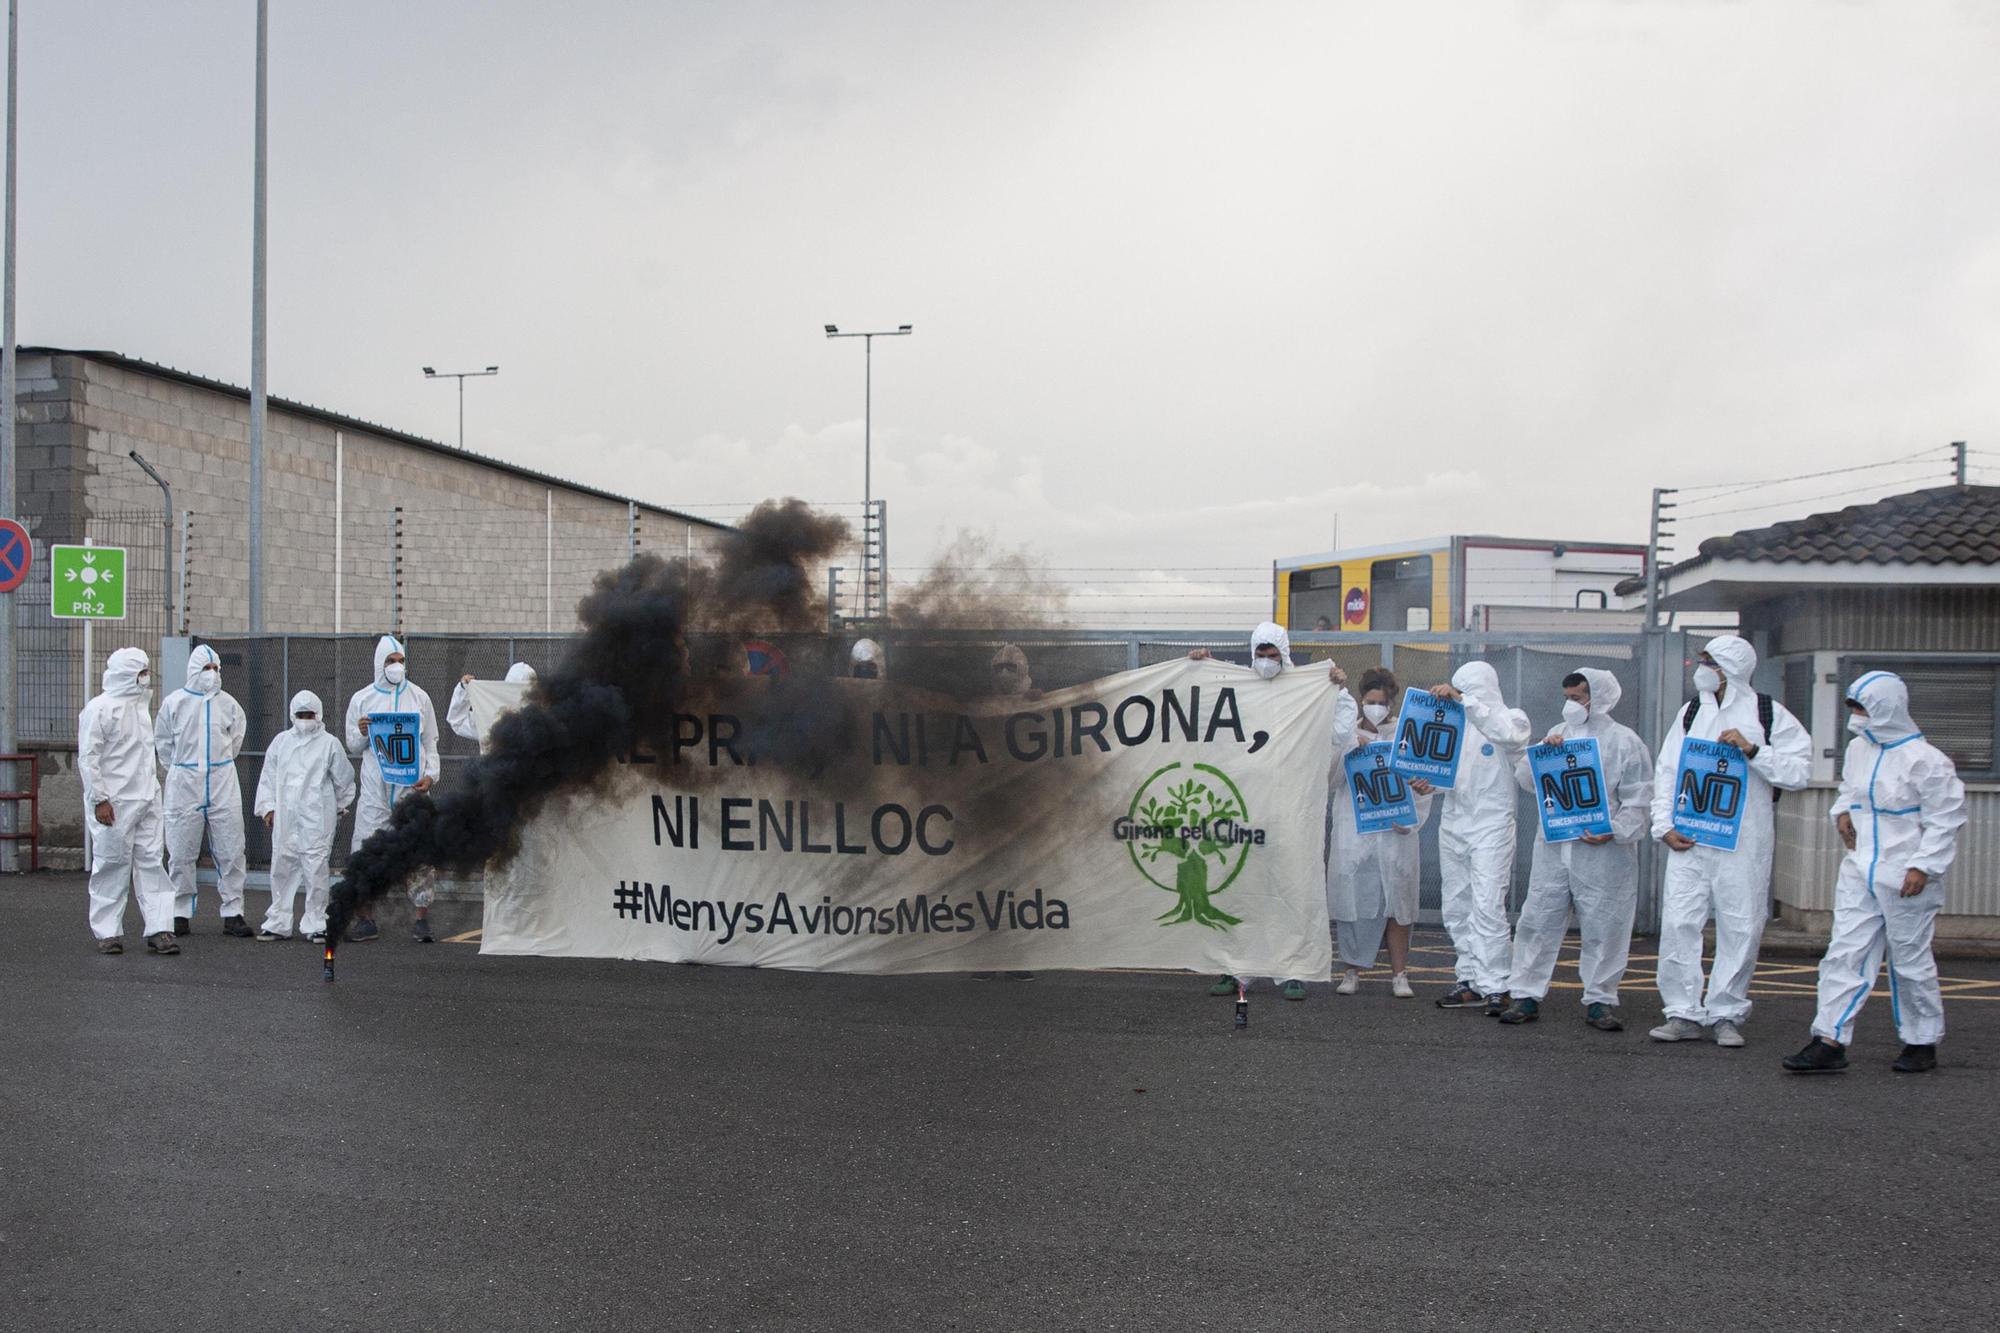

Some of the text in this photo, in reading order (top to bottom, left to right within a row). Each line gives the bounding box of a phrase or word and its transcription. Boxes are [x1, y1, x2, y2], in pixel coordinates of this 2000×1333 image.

[73, 602, 105, 614] PR-2
[872, 711, 926, 766] NI
[949, 715, 989, 764] A
[1005, 685, 1270, 762] GIRONA,
[1401, 718, 1458, 761] NO
[374, 733, 416, 765] NO
[1541, 767, 1601, 811] NO
[1680, 769, 1742, 819] NO
[651, 795, 954, 856] NI ENLLOC
[1113, 816, 1265, 849] Girona pel Clima
[613, 880, 1069, 945] #MenysAvionsMésVida
